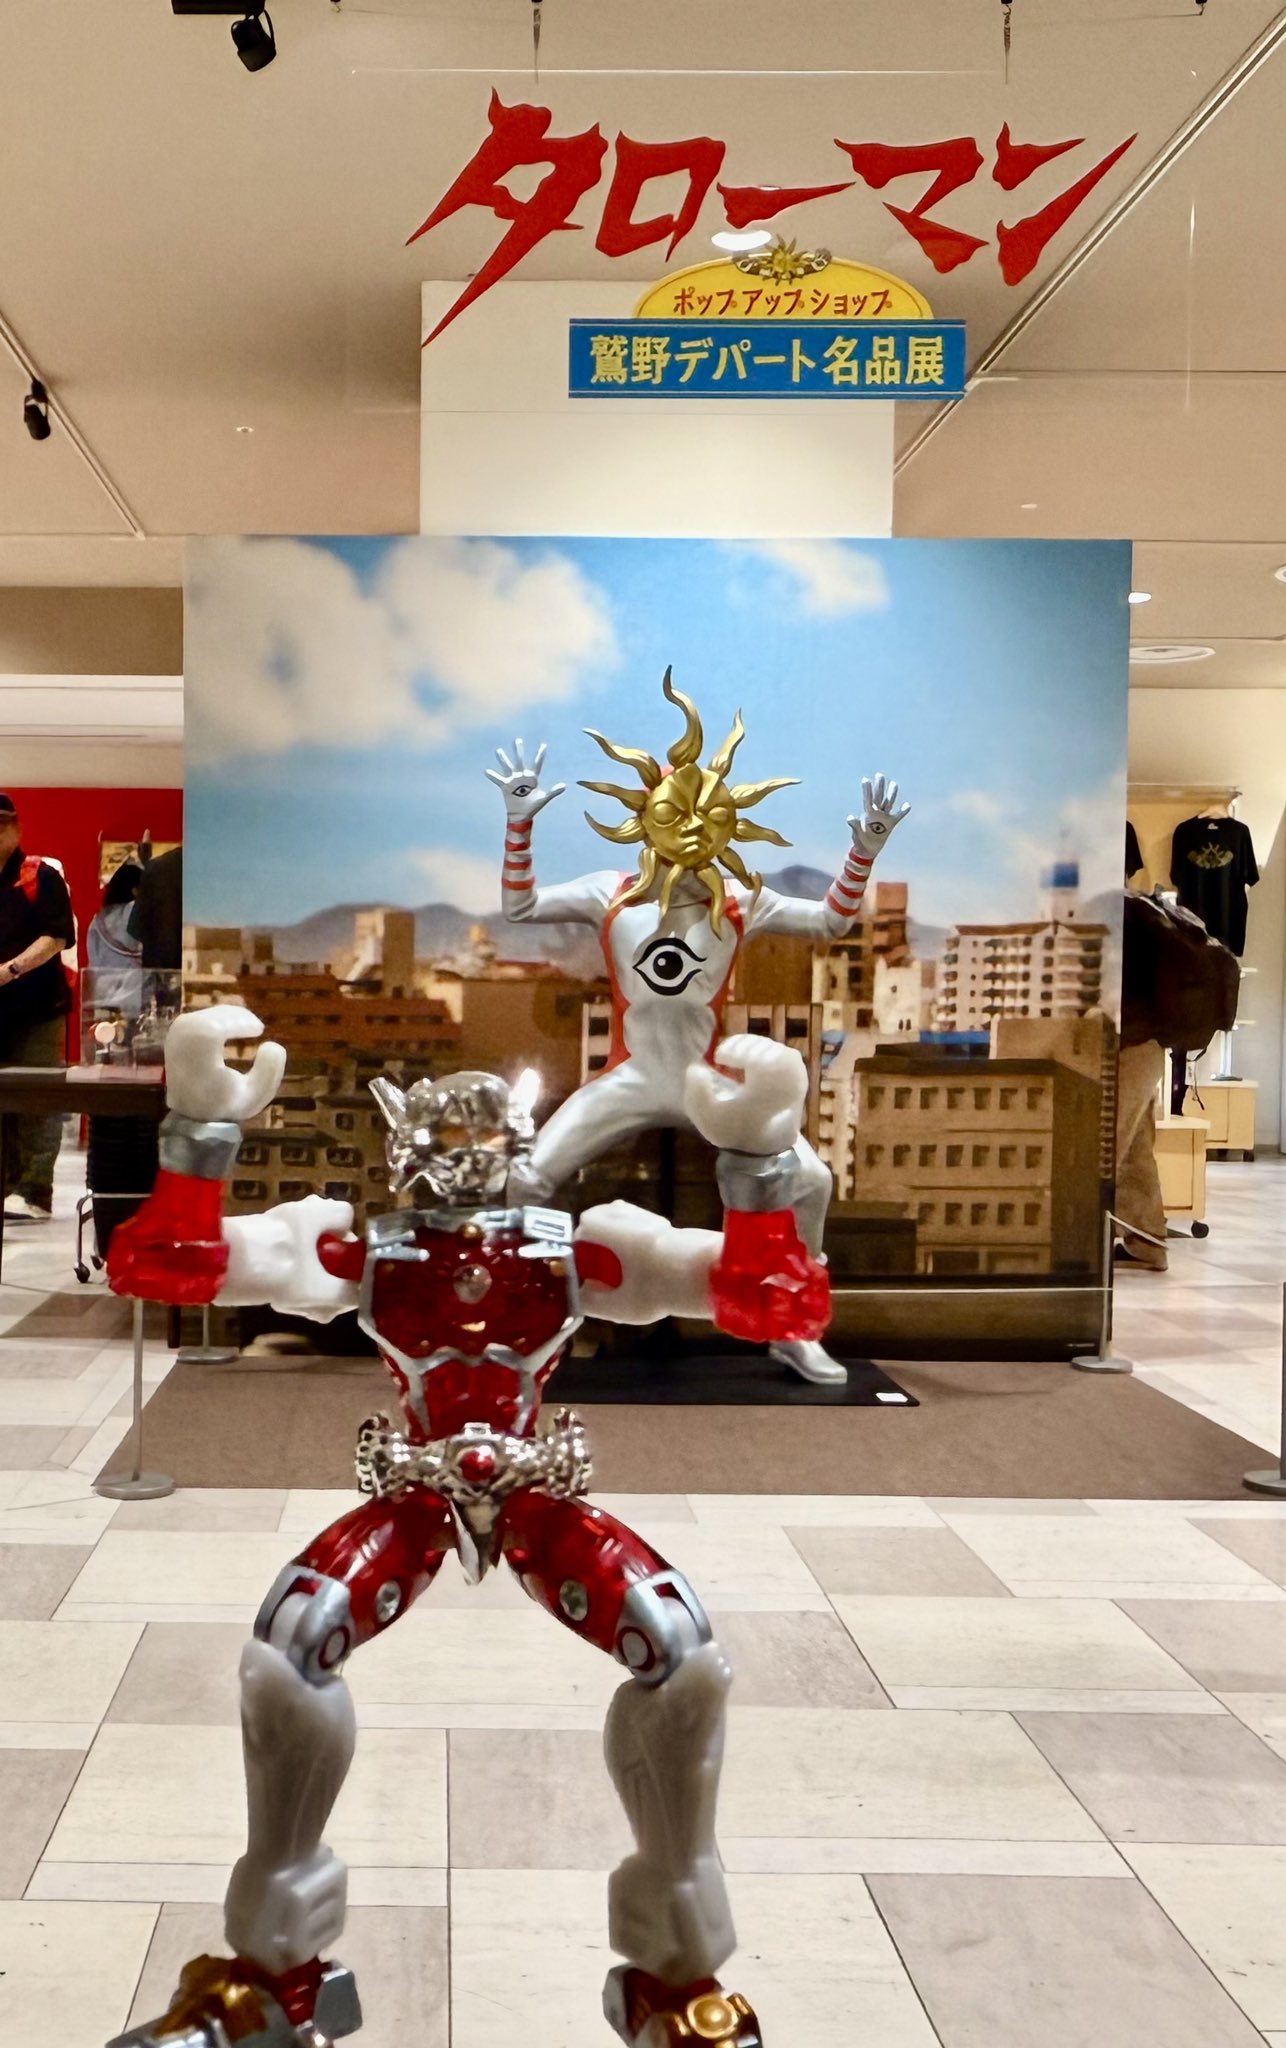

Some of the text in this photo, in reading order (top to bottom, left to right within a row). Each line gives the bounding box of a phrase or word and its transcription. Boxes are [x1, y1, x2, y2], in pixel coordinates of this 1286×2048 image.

[406, 87, 1138, 347] タローマン
[672, 286, 894, 316] ポップアップショップ
[590, 334, 945, 386] 鷲野デパート名品展
